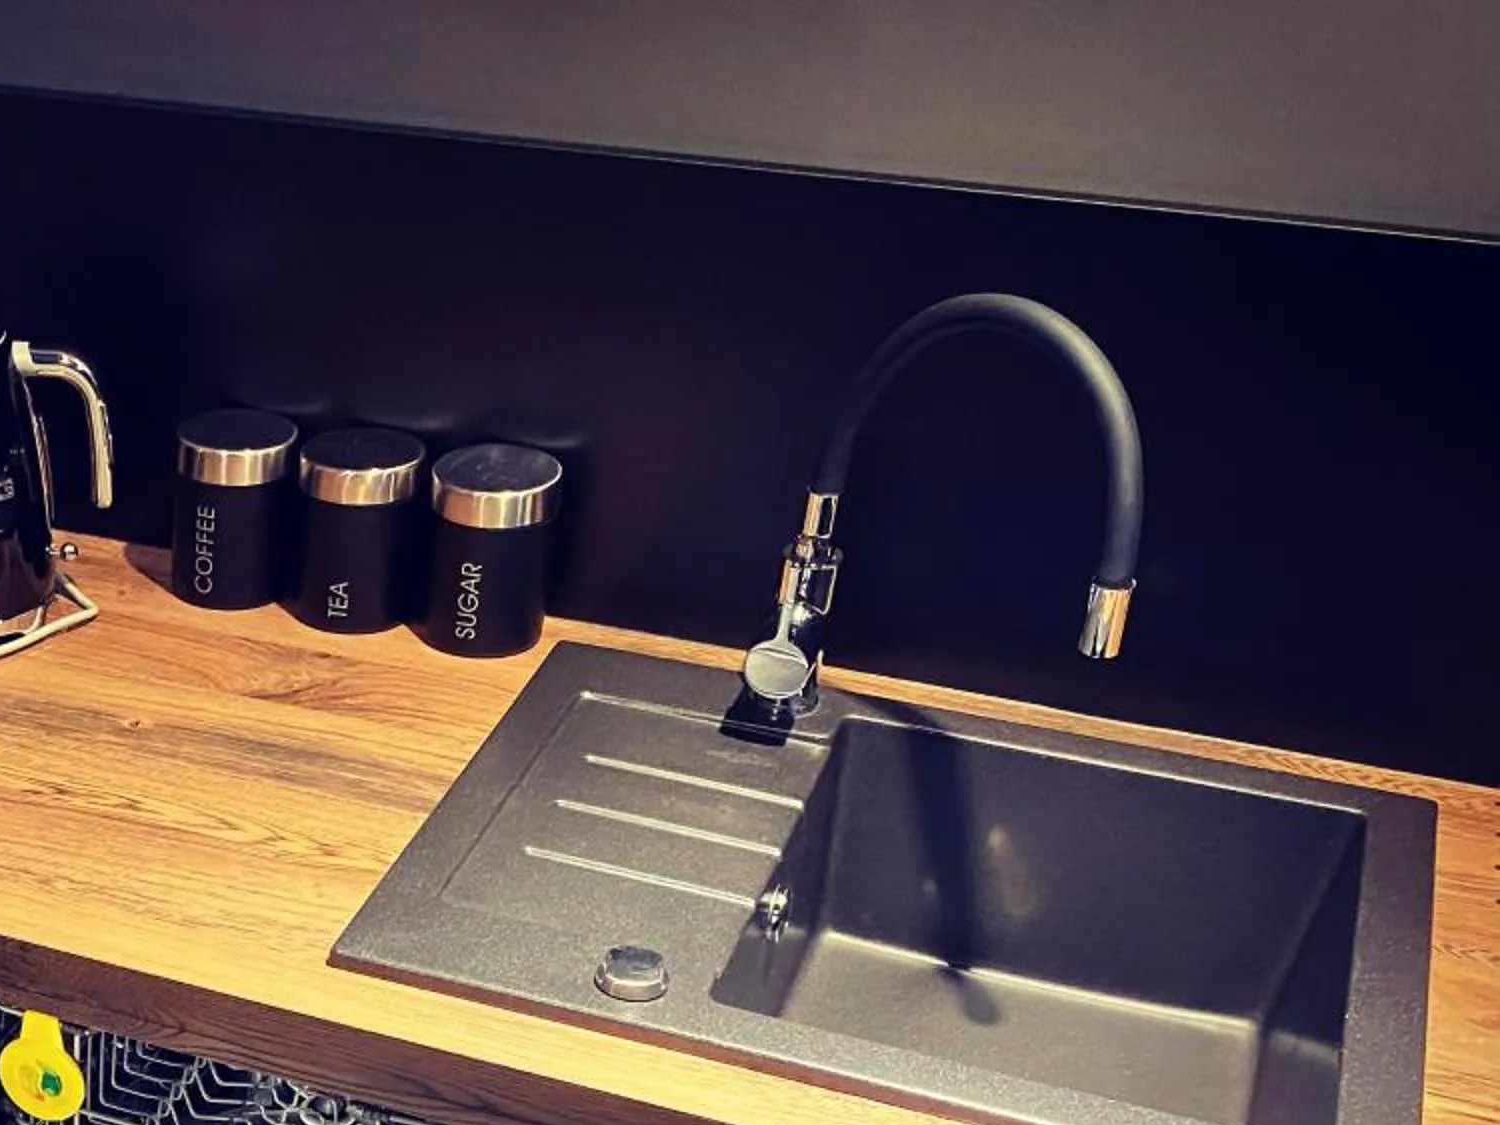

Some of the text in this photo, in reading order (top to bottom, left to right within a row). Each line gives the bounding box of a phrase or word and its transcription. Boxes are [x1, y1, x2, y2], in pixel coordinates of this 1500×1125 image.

[195, 506, 215, 594] COFFEE
[327, 581, 349, 618] TEA
[455, 562, 483, 640] SUGAR
